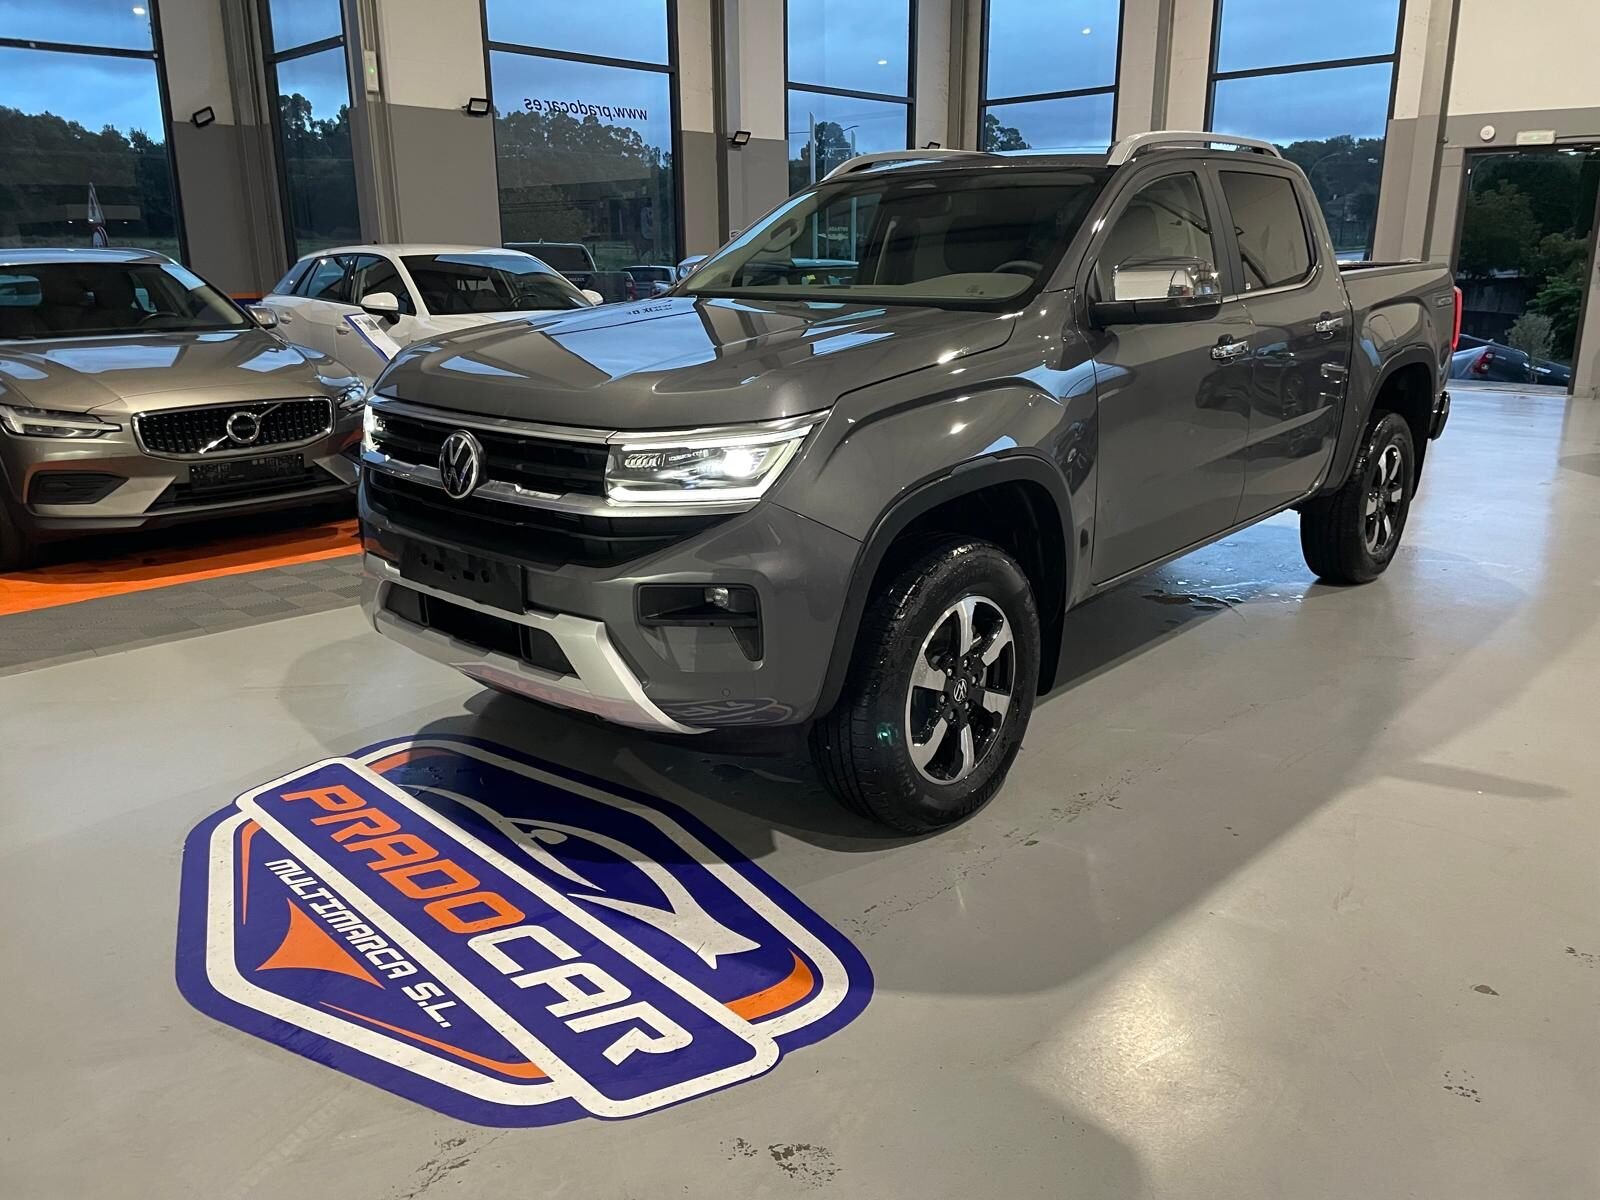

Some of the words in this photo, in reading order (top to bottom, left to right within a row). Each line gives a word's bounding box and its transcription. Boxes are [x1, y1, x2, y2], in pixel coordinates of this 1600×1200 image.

[264, 858, 419, 980] MULTIMARCA
[401, 982, 457, 1029] S.L.
[279, 784, 694, 1067] PRADOCAR
